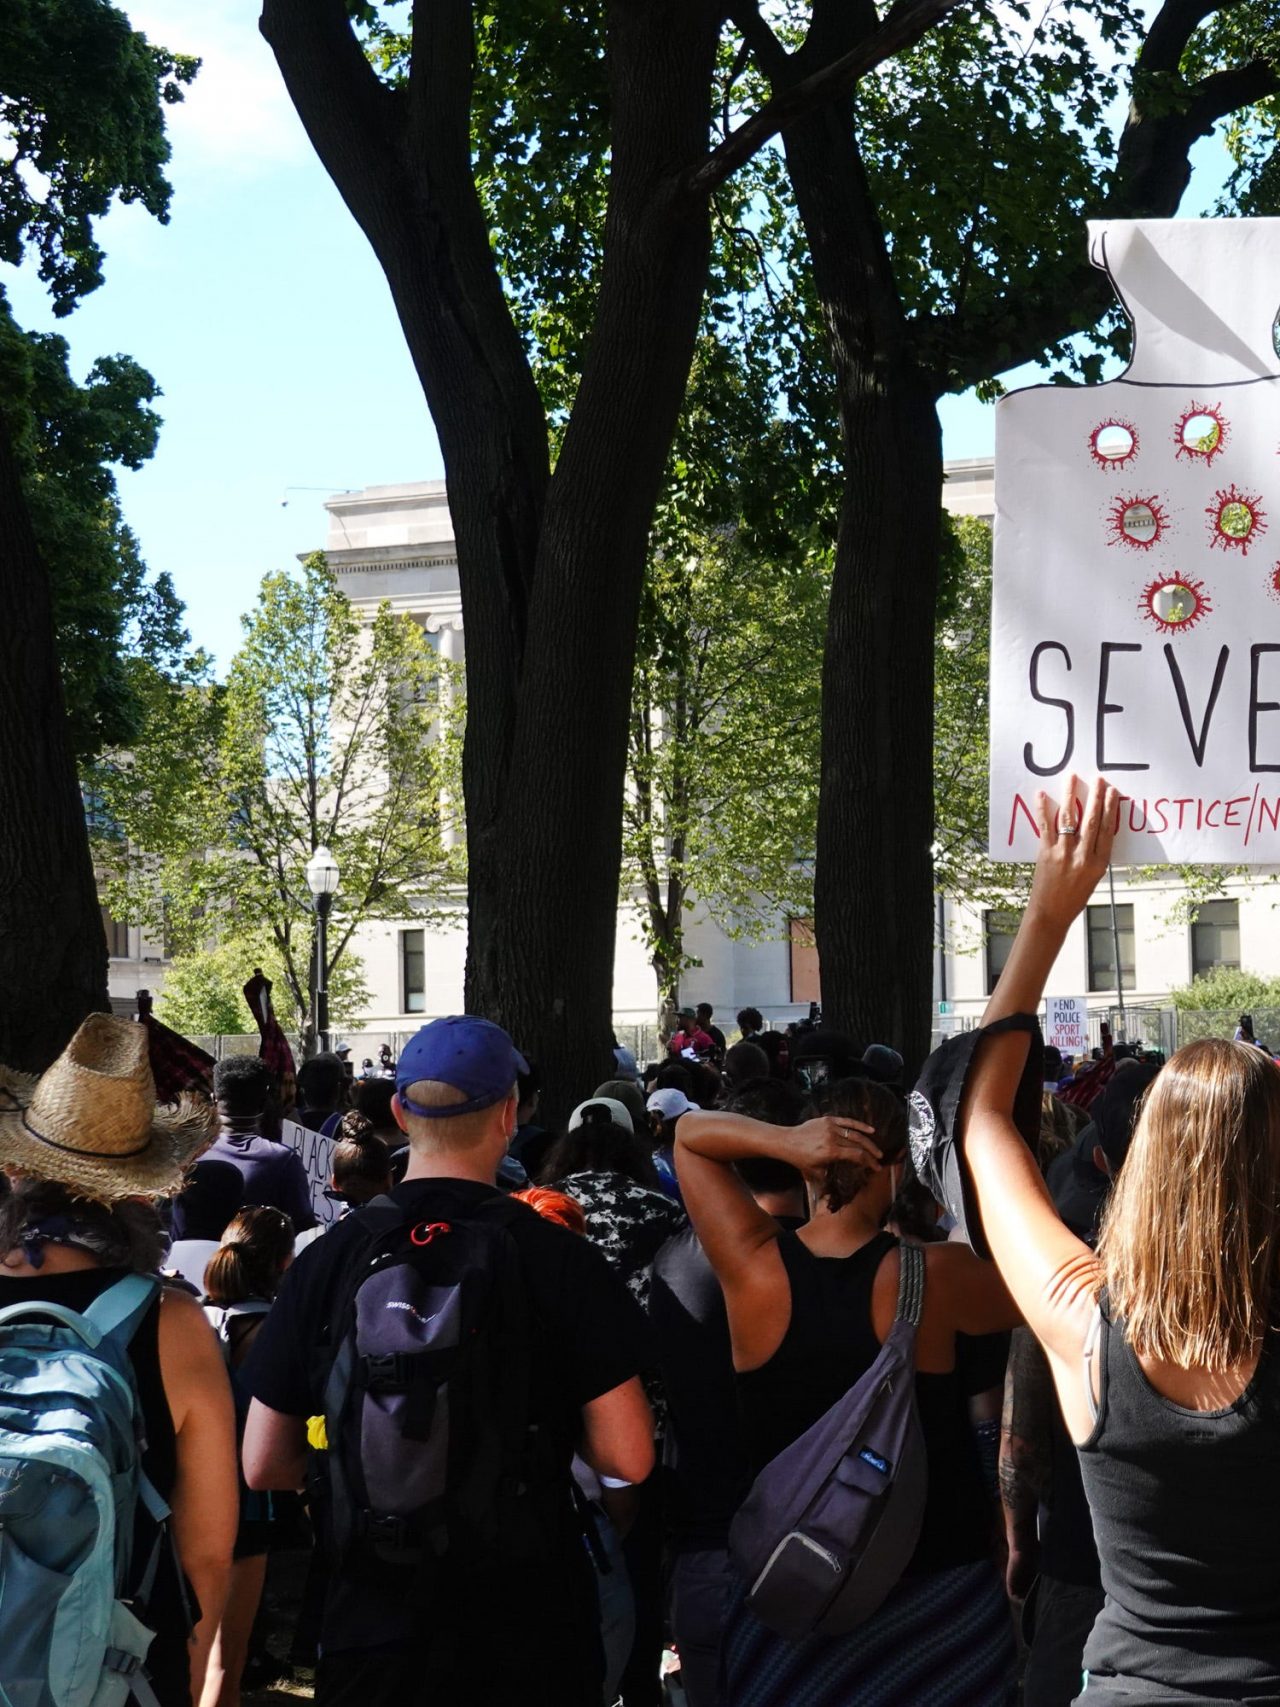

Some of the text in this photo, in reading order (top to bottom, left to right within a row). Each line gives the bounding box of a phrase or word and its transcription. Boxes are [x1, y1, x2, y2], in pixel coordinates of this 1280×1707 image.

[1054, 1012, 1081, 1023] POLICE
[1055, 1024, 1080, 1035] SPORT
[1050, 1036, 1083, 1047] KILLING!
